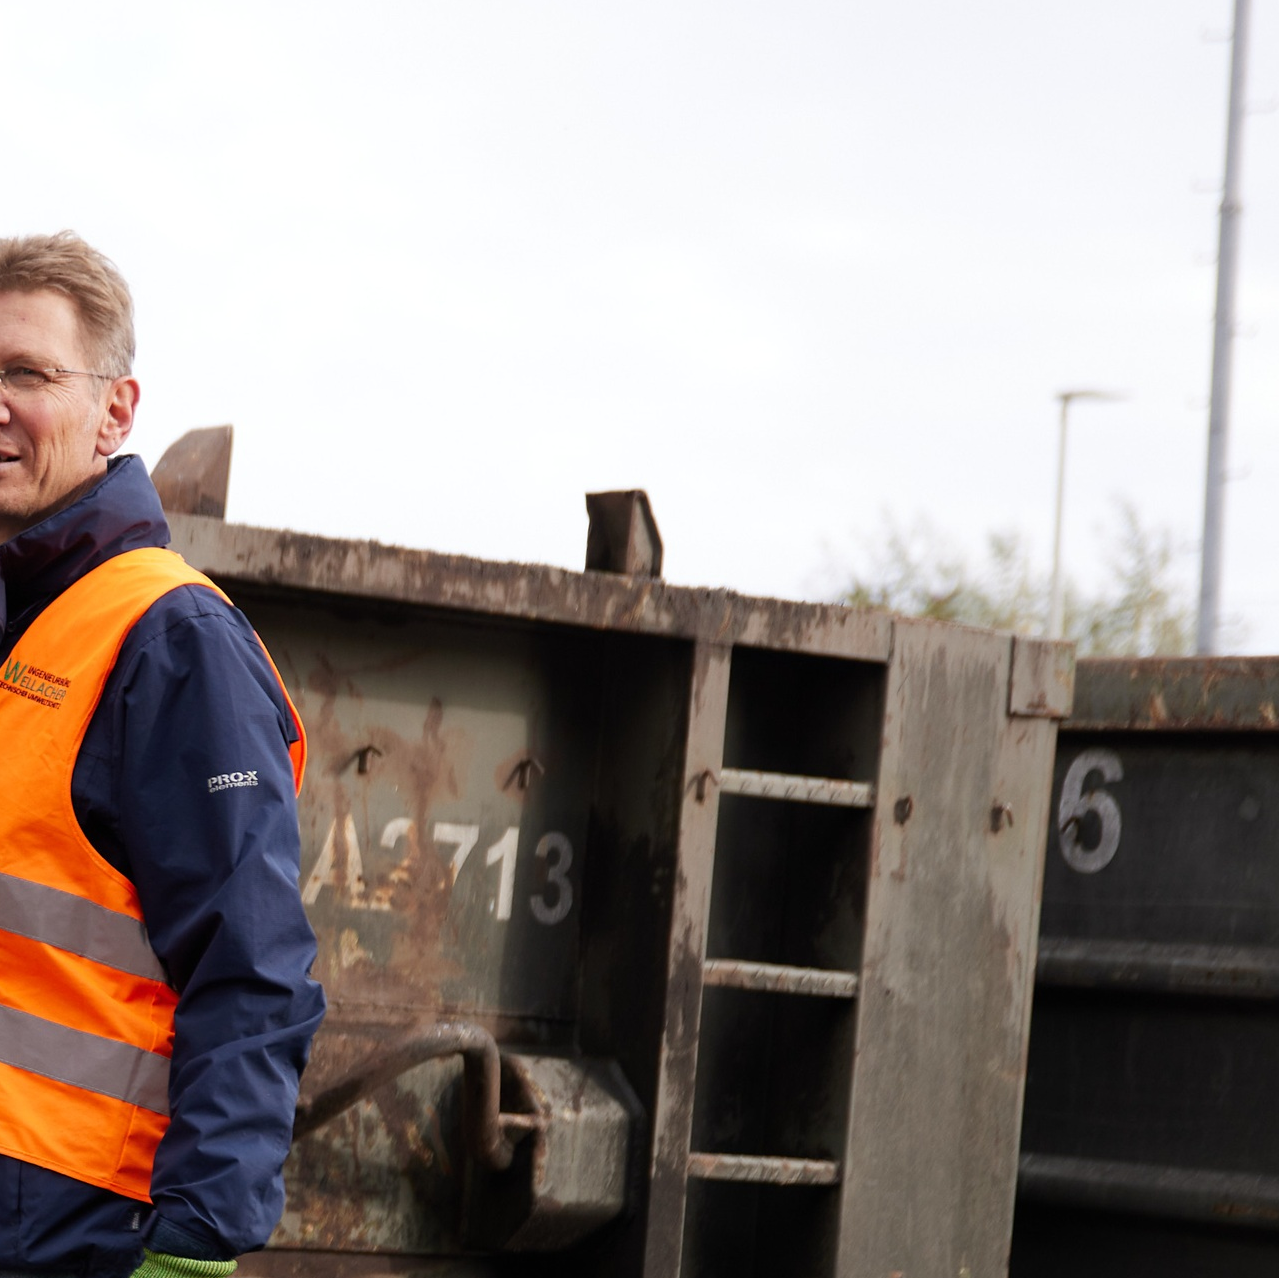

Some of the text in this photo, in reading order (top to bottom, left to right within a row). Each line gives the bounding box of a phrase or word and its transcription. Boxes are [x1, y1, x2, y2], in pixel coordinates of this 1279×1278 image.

[4, 658, 67, 701] WELLACHER
[207, 770, 259, 788] PRO-X
[209, 780, 259, 793] elements
[1058, 750, 1124, 874] 6
